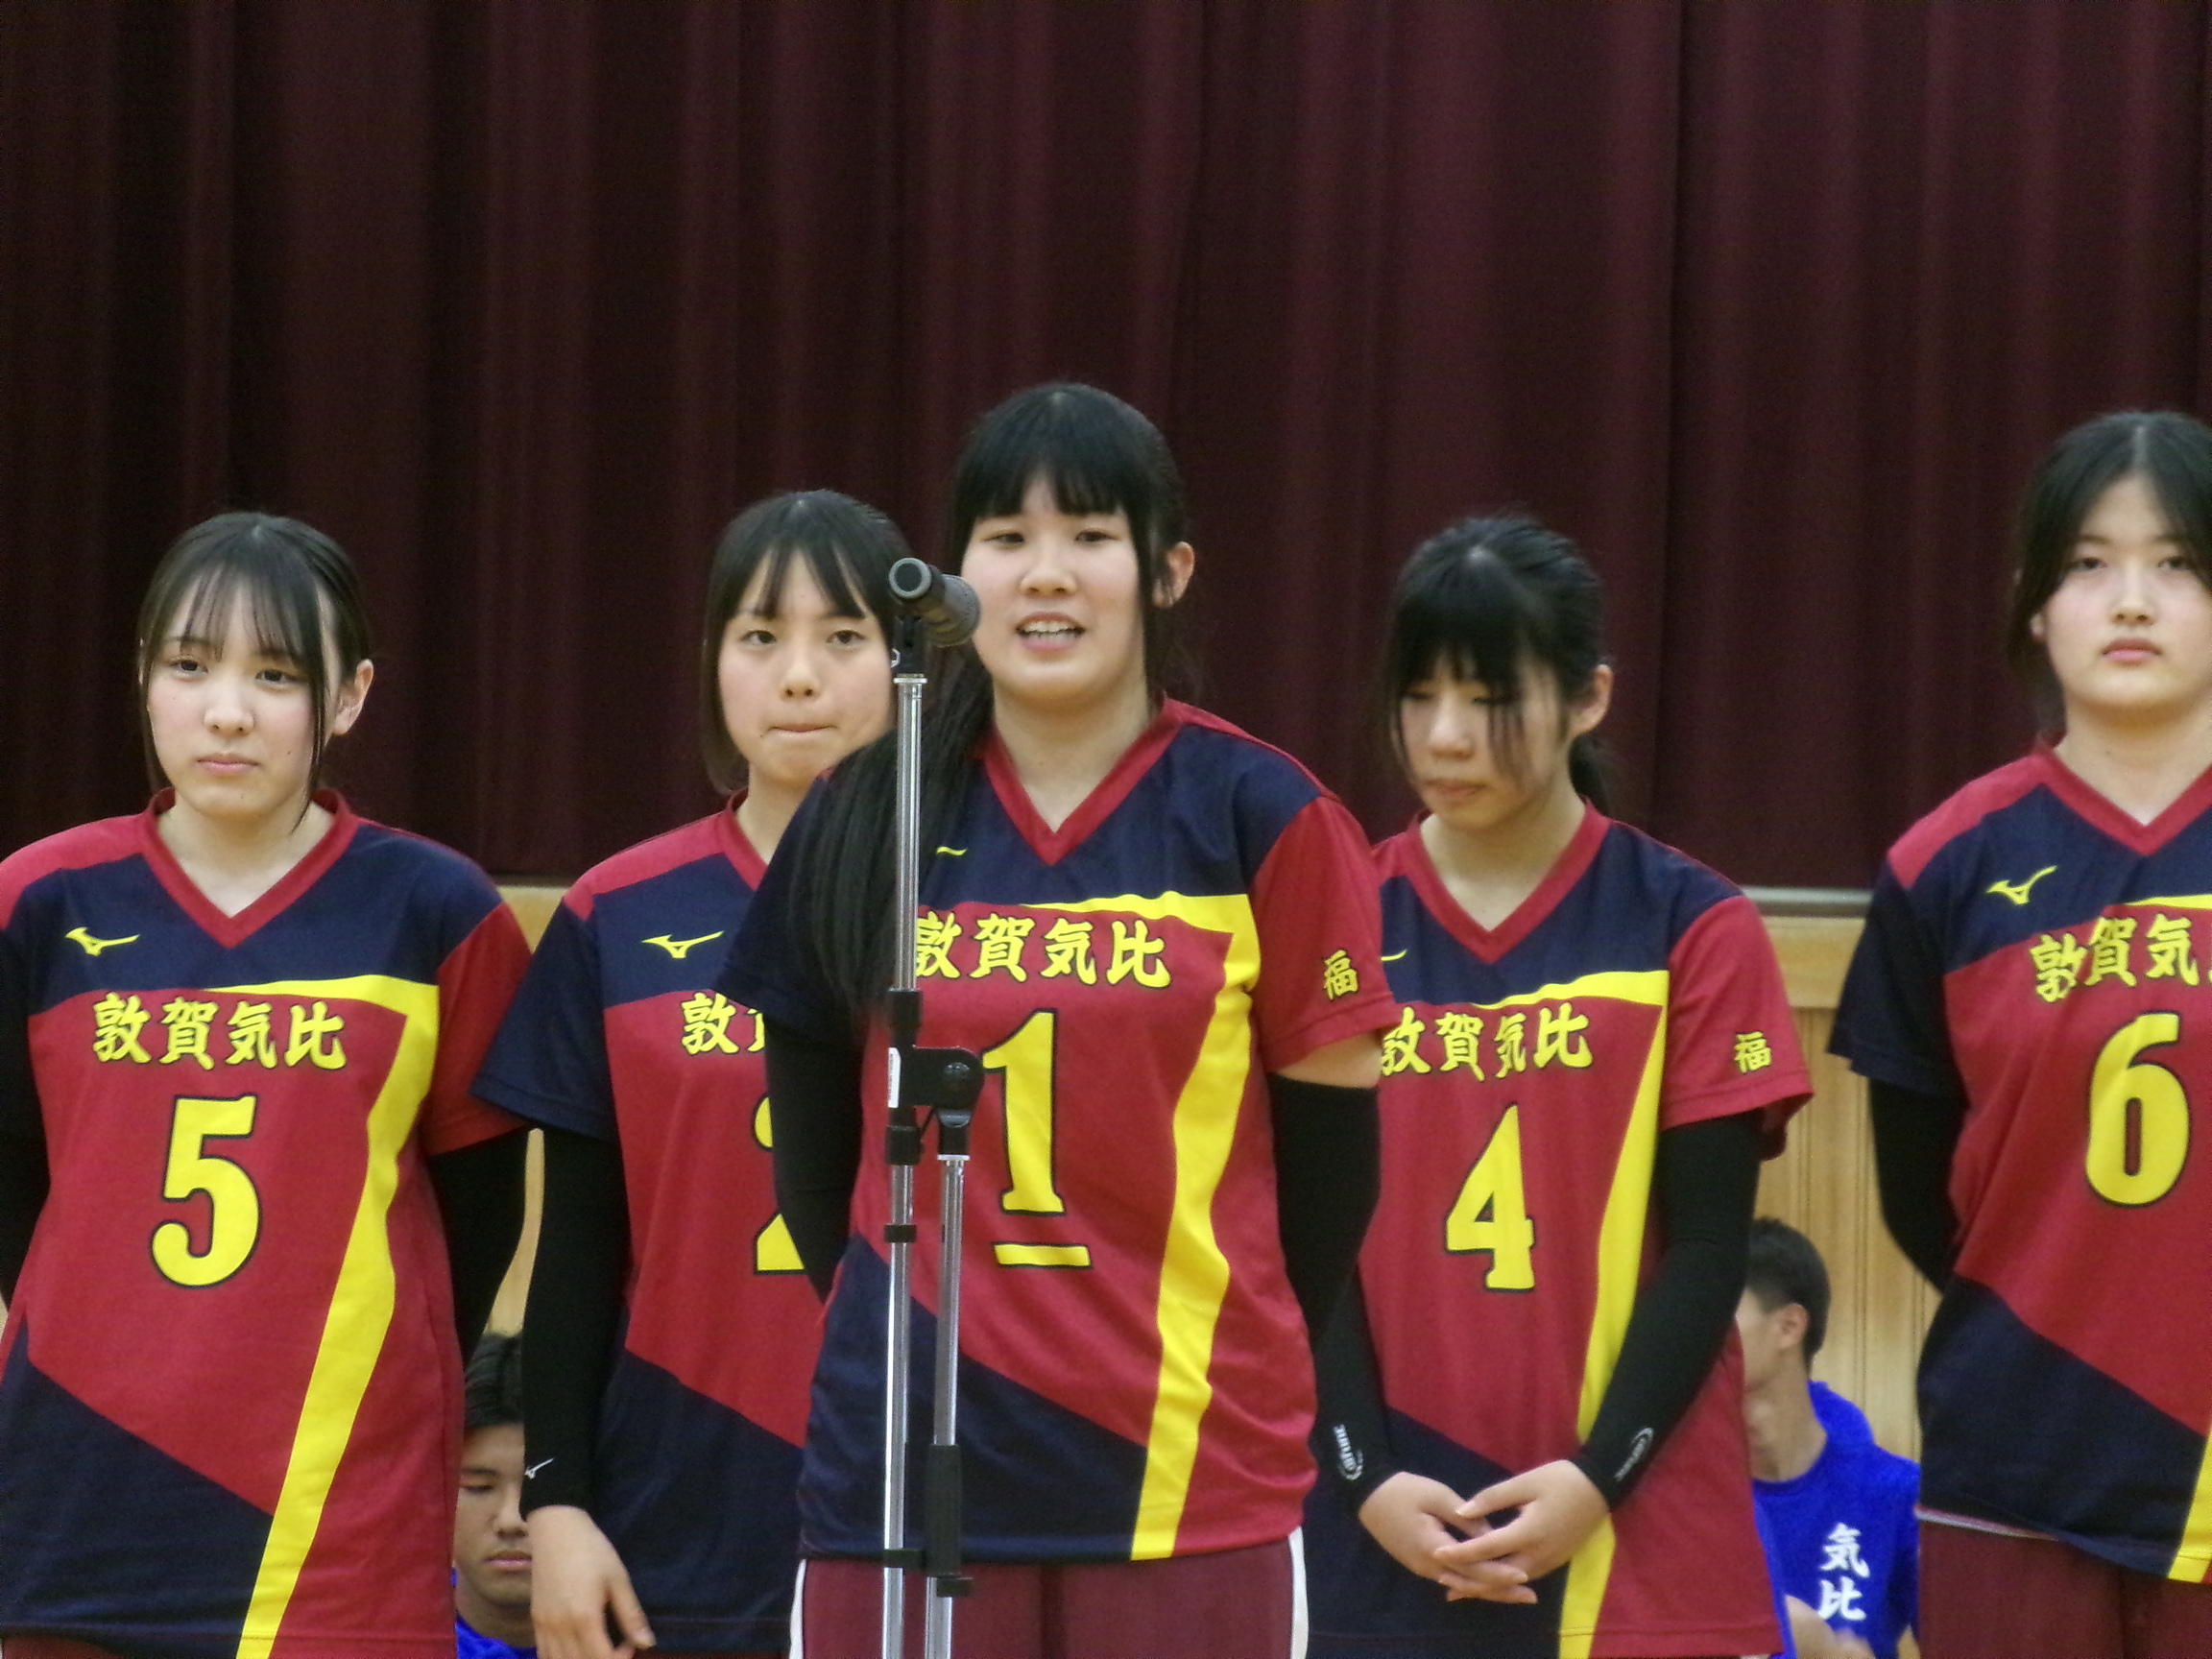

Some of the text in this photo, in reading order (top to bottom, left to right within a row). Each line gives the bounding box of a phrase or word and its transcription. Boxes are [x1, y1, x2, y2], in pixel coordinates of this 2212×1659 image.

[916, 910, 1172, 988] 敦賀気比
[1323, 949, 1359, 999] 福
[2029, 913, 2212, 1003] 敦賀気
[92, 992, 348, 1070] 敦賀気比
[1382, 1002, 1594, 1082] 敦賀気比
[1733, 1030, 1773, 1074] 福
[981, 1010, 1066, 1214] 1
[2084, 1010, 2191, 1208] 6
[150, 1094, 261, 1288] 5
[1444, 1103, 1536, 1292] 4
[1817, 1522, 1871, 1623] 気比
